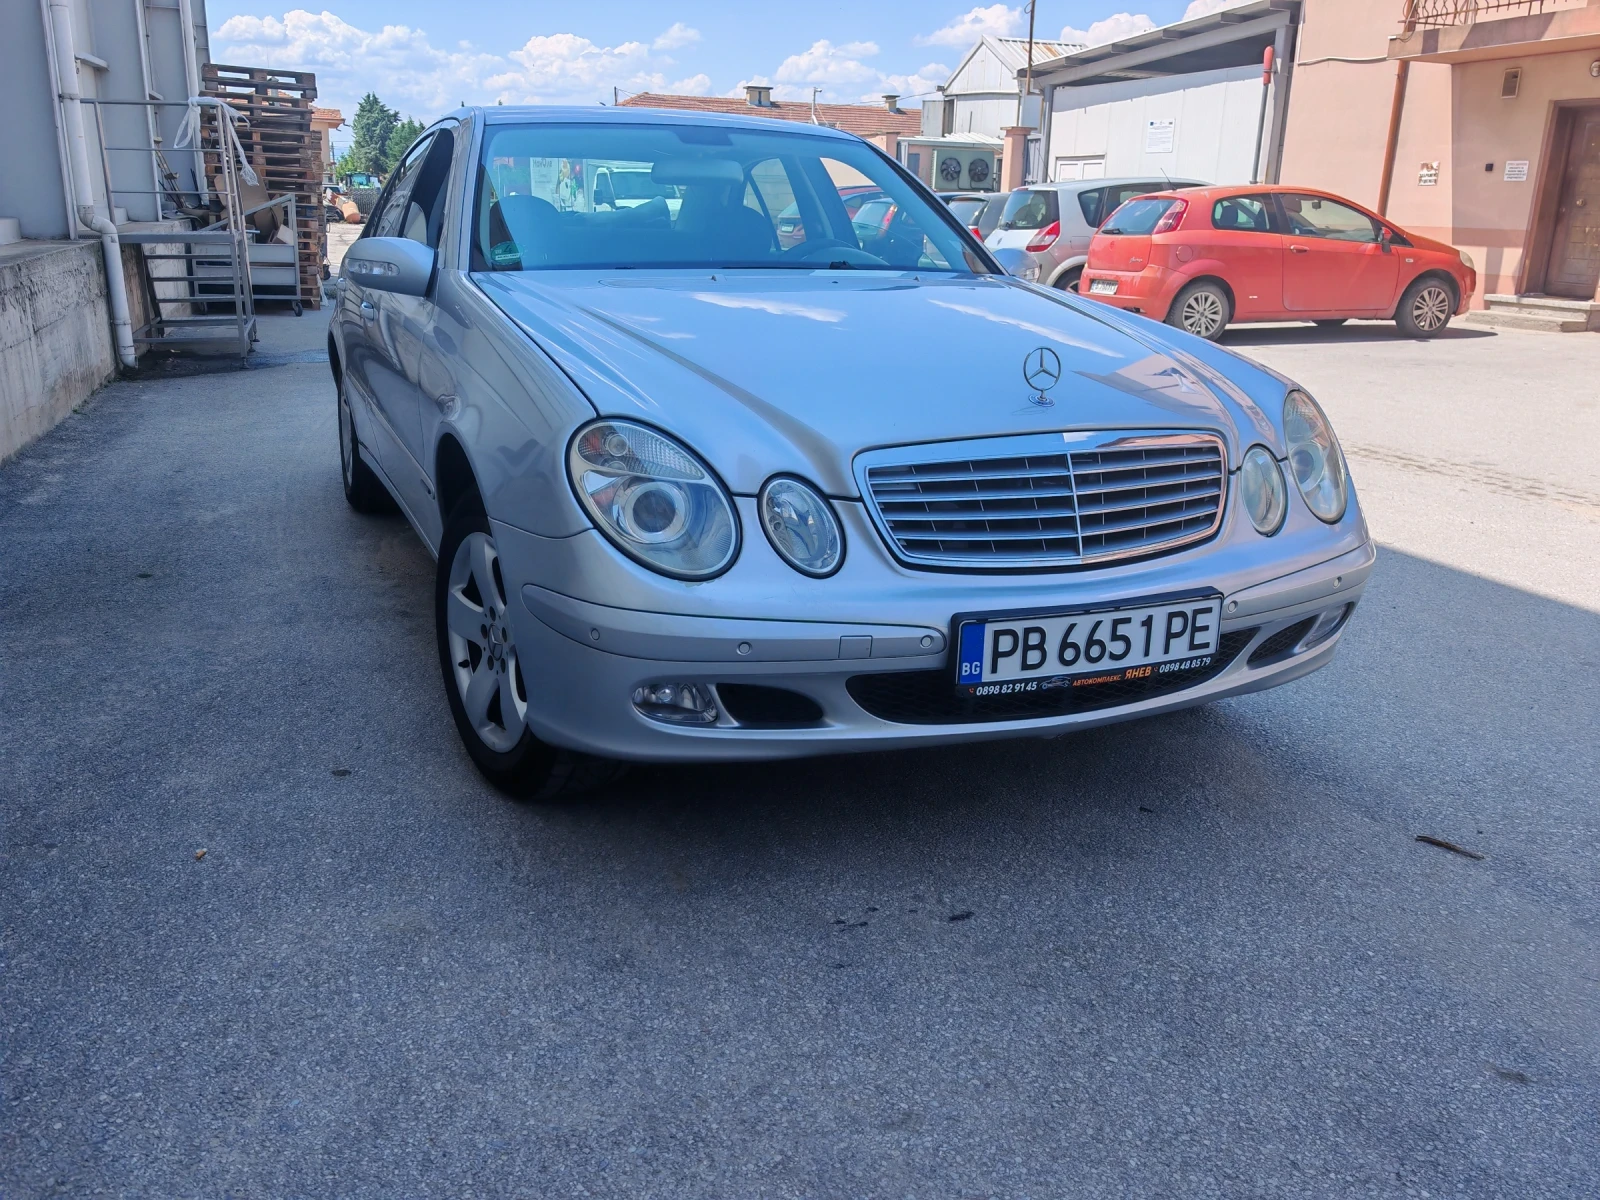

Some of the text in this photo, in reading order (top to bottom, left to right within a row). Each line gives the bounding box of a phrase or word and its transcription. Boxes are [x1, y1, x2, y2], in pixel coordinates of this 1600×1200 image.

[990, 606, 1214, 674] PB 6651 PE
[961, 661, 981, 676] BG
[1159, 656, 1211, 673] 0898 48 85 79
[1072, 666, 1152, 686] АВТОКОМПЛЕКС ЯНЕВ
[976, 681, 1038, 696] 0898 82 91 45
